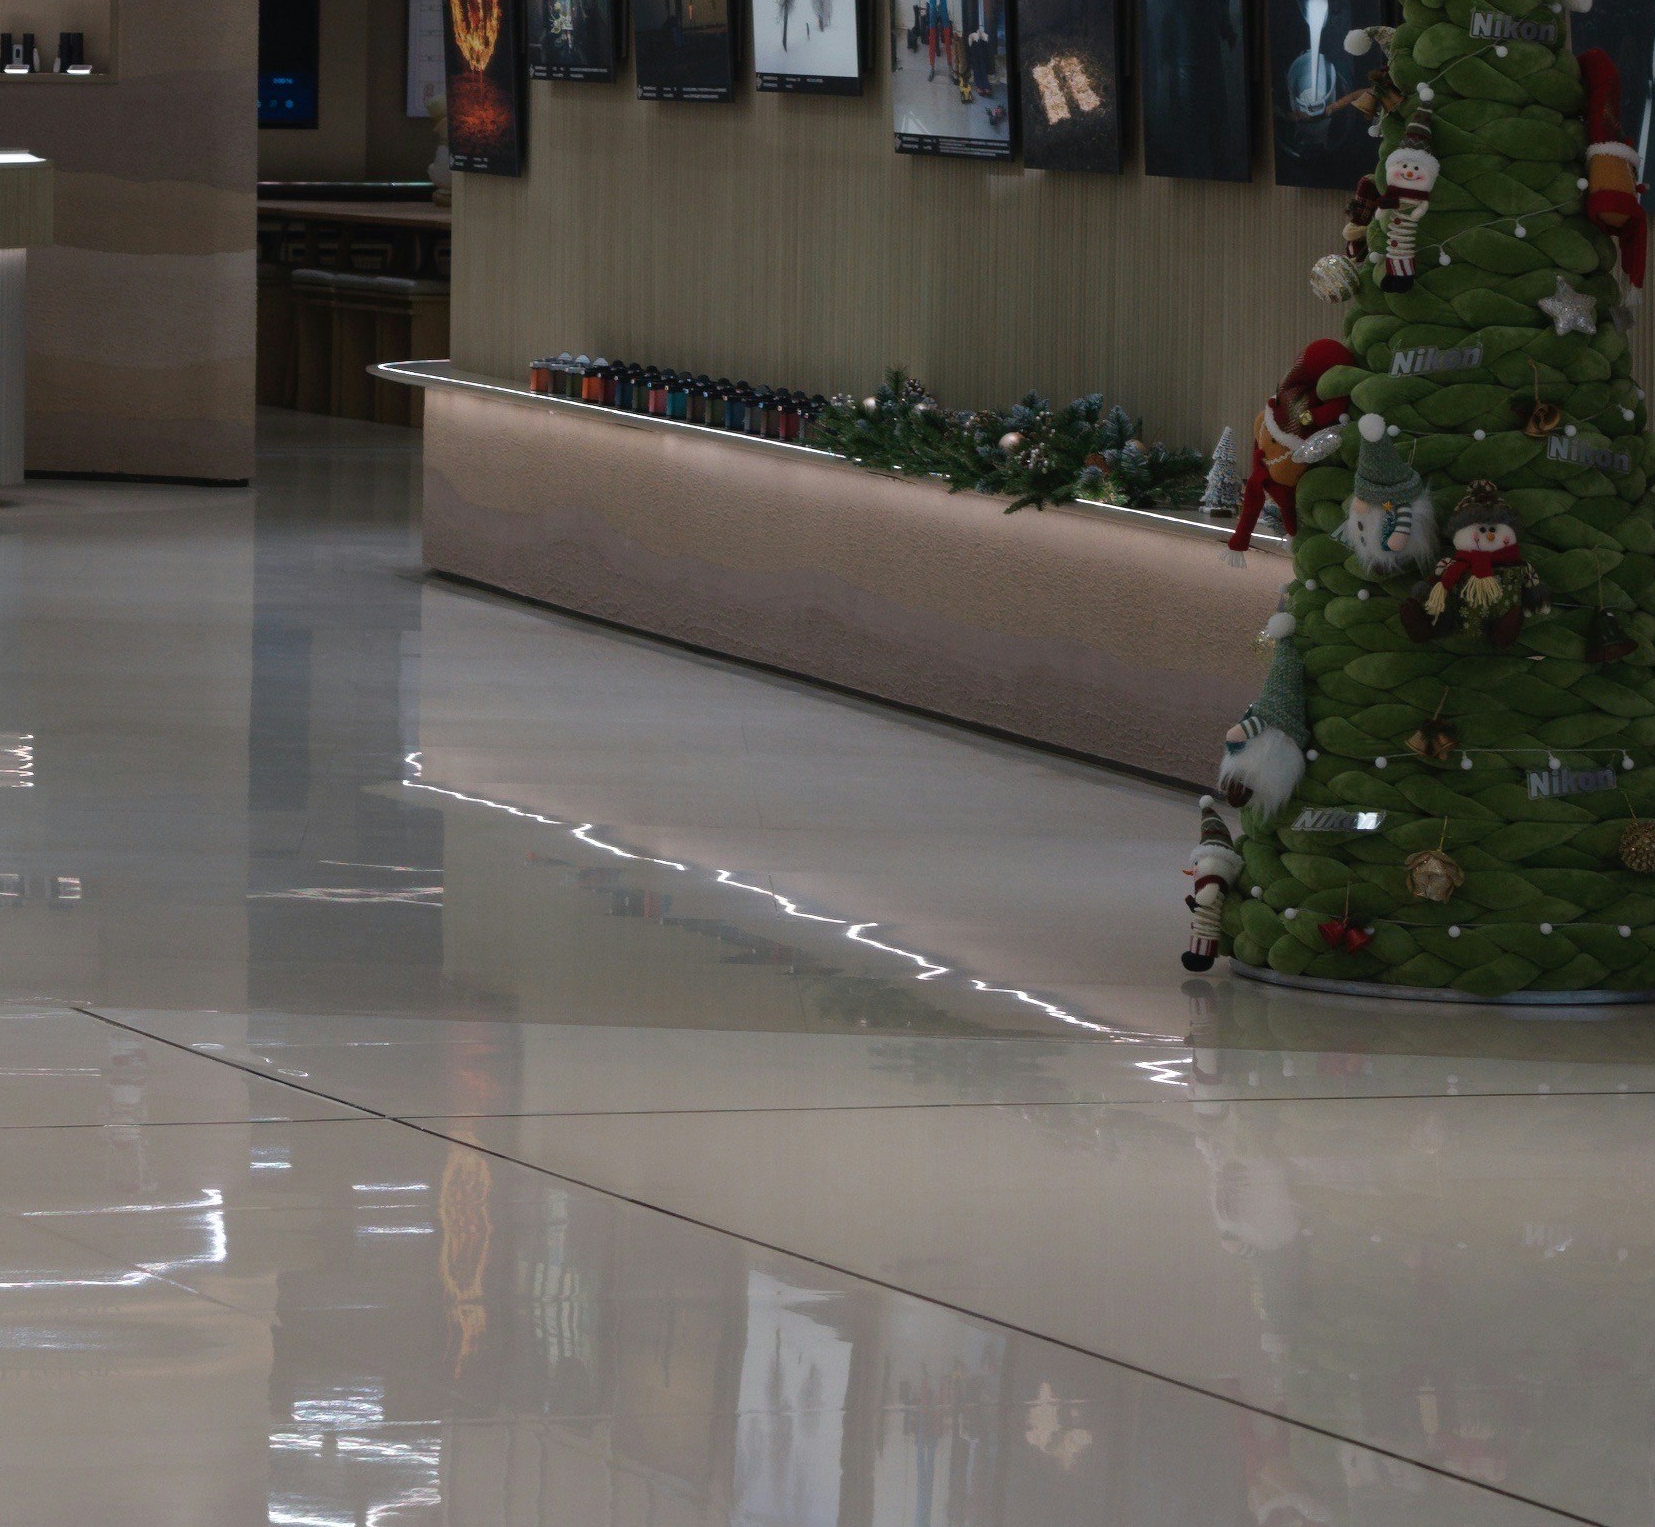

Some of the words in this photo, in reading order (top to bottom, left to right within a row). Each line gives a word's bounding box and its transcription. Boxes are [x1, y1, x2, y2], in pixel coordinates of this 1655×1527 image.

[1471, 11, 1557, 42] Nikon
[1390, 347, 1481, 376] Nikon
[1549, 435, 1630, 473] Nikon
[1529, 768, 1615, 797] Nikon
